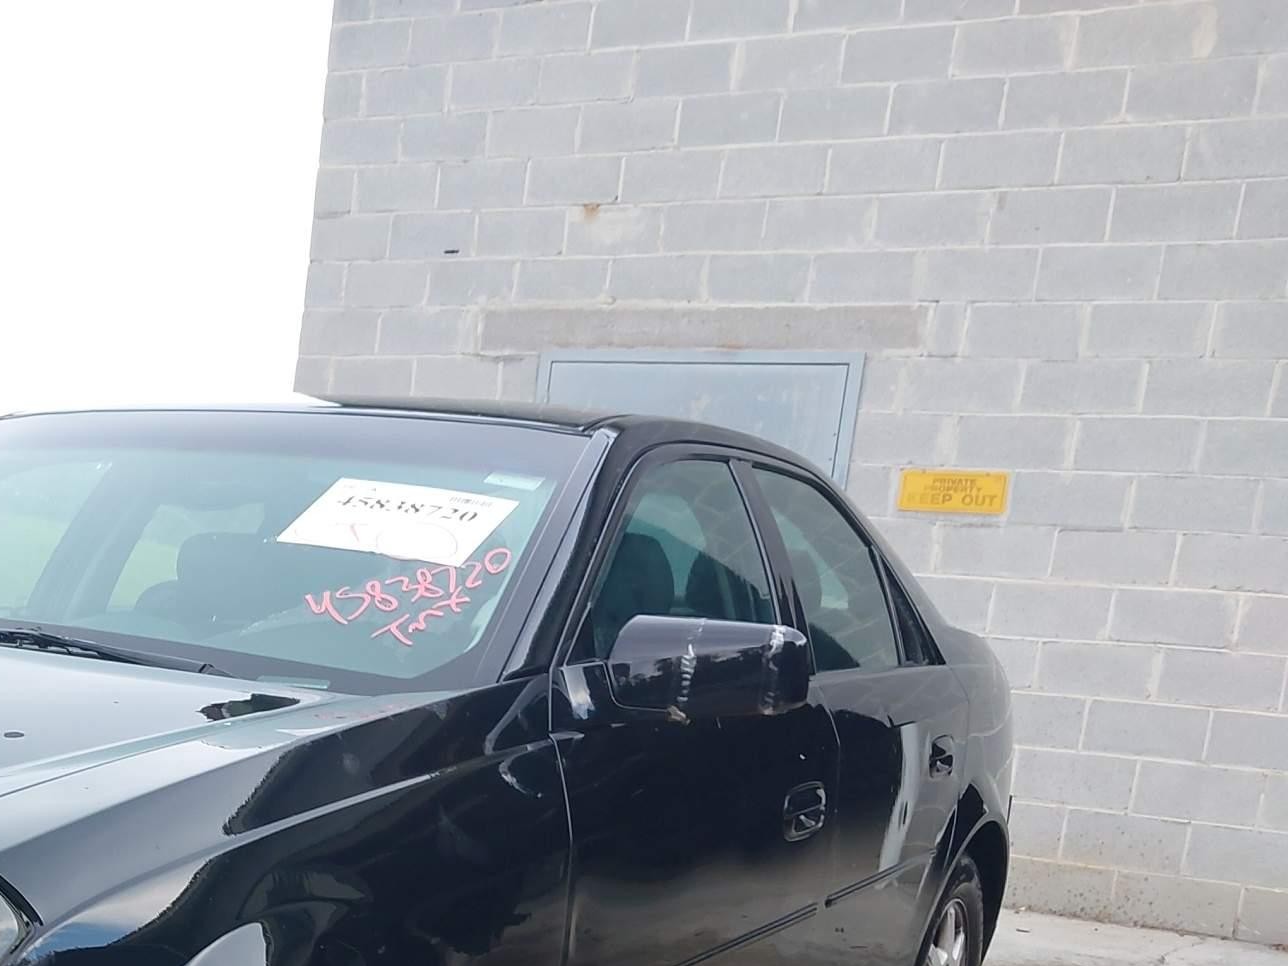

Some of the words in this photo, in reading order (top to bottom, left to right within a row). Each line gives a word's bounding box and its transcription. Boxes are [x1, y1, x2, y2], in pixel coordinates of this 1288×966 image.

[932, 478, 977, 487] PRIVATE
[961, 494, 998, 507] OUT
[337, 496, 478, 522] 45838720
